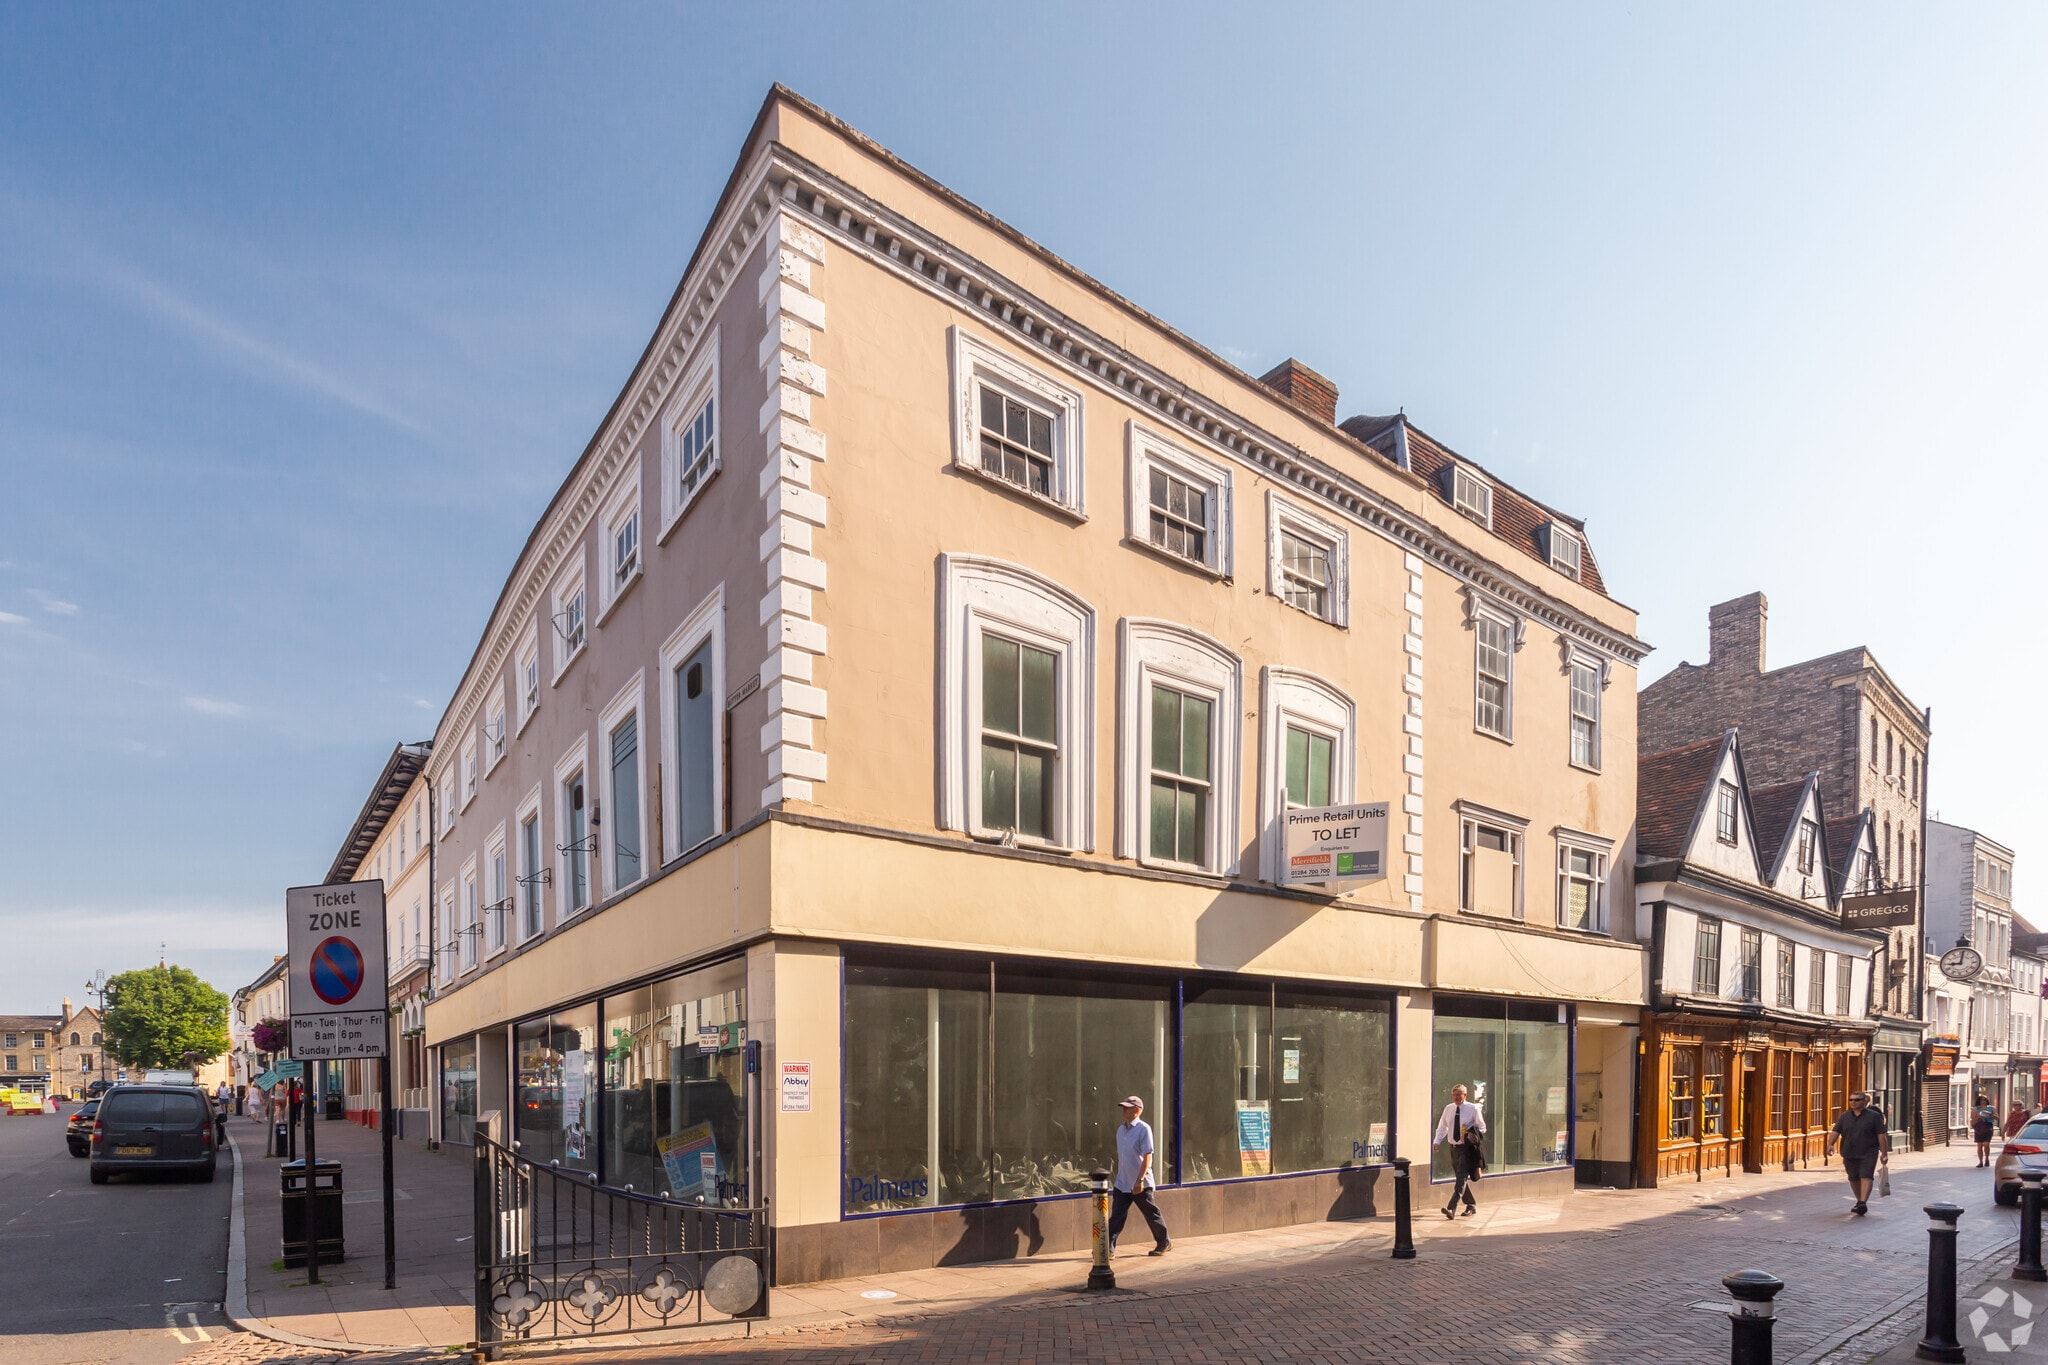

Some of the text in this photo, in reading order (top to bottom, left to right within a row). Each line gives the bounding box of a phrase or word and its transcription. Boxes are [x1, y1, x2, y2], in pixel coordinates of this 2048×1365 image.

[1289, 808, 1385, 825] Prime Retail Units
[1312, 827, 1360, 842] TO LET
[1292, 854, 1330, 866] Merrifields
[313, 890, 356, 908] Ticket
[1860, 904, 1908, 917] GREGGS
[309, 910, 361, 931] ZONE
[294, 1019, 313, 1028] Mon
[343, 1016, 363, 1026] Thur
[370, 1015, 382, 1024] Fri
[314, 1031, 320, 1040] 8
[341, 1030, 347, 1039] 6
[348, 1031, 362, 1040] pm
[298, 1045, 330, 1056] Sunday
[358, 1044, 364, 1052] 4
[366, 1044, 380, 1054] pm
[1353, 1140, 1388, 1158] Palmers
[850, 1174, 928, 1203] Palmers
